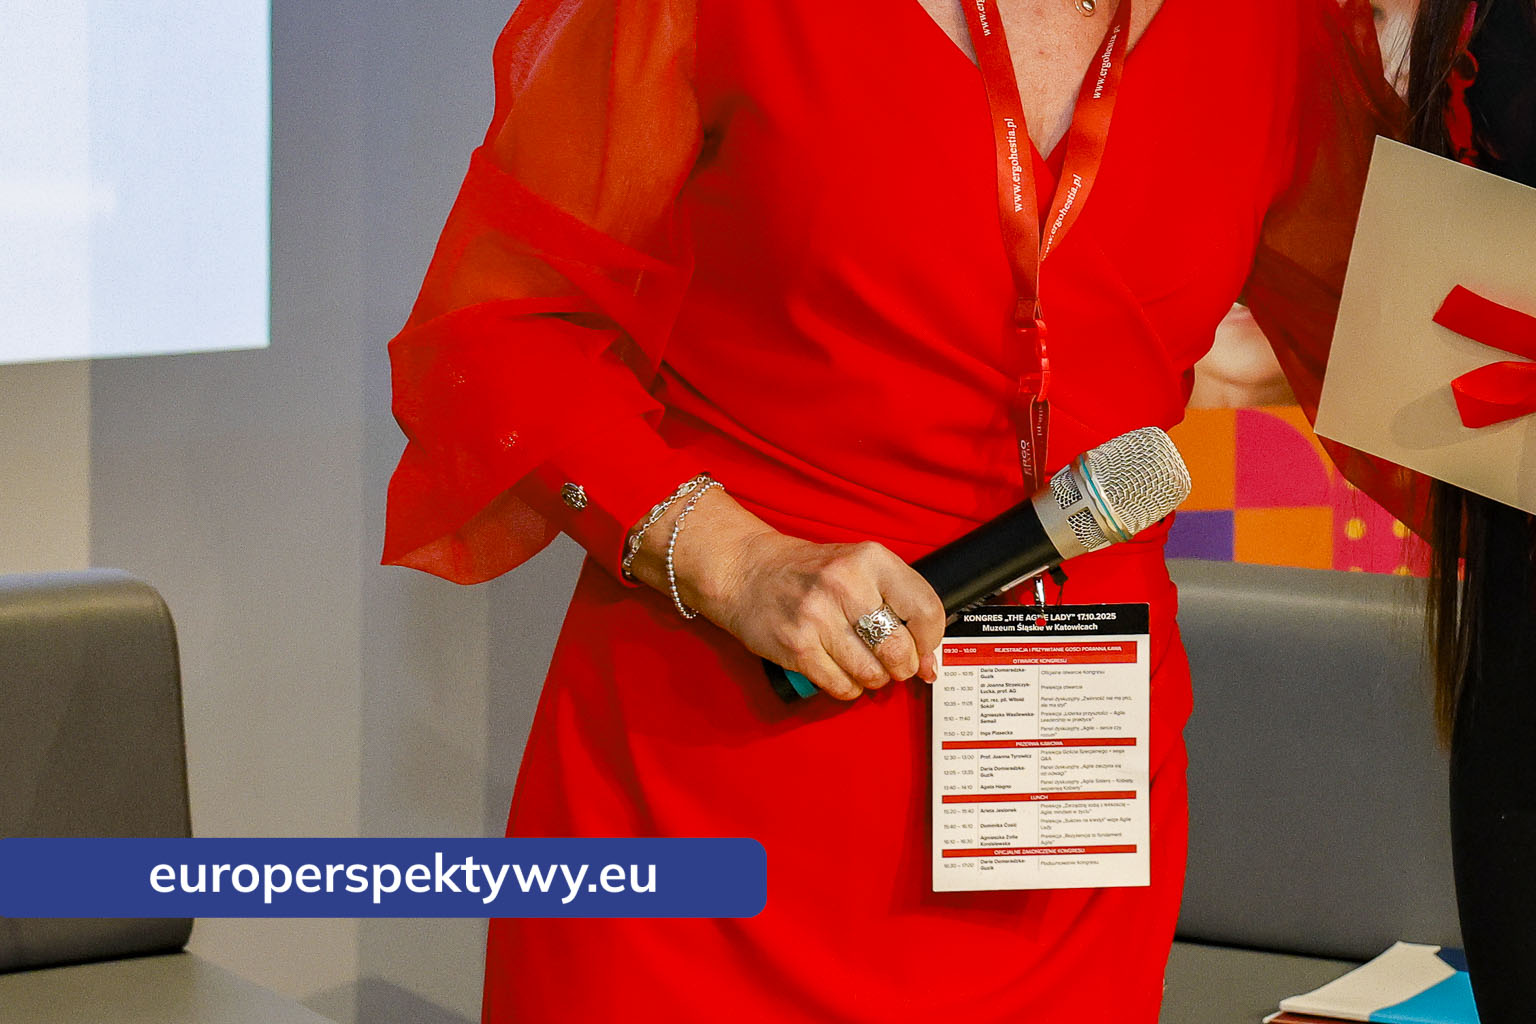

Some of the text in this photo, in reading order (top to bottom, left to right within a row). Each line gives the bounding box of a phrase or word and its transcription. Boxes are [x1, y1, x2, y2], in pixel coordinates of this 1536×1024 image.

[1004, 118, 1023, 213] www.ergohestia.pl
[963, 614, 1003, 622] KONGRES
[1025, 613, 1049, 621] AGE
[1076, 612, 1117, 620] 17.10.2025
[982, 624, 1015, 632] Muzeum
[1054, 623, 1098, 632] Katowicach
